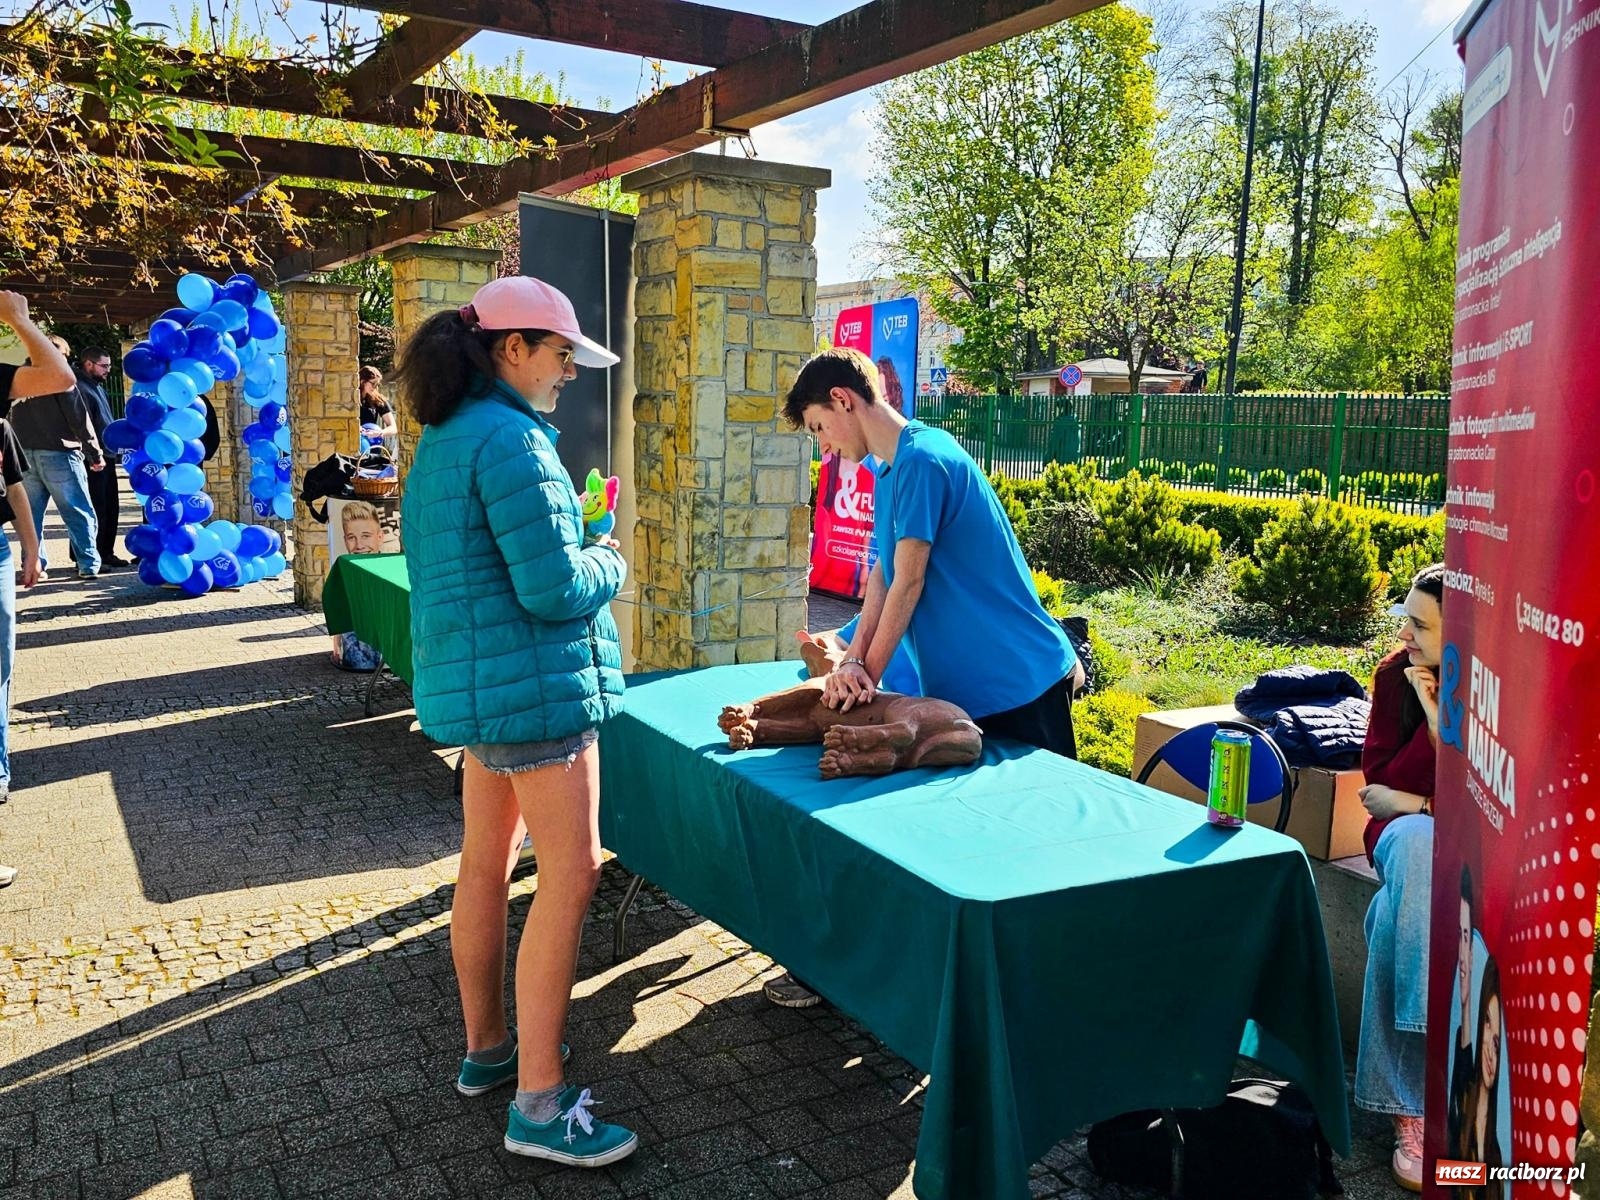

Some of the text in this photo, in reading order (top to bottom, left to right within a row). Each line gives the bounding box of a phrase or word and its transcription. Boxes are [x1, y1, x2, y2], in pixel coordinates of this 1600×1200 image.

[849, 321, 863, 334] TEB
[894, 314, 908, 328] TEB
[860, 492, 875, 511] FU
[1544, 613, 1560, 641] 42
[1561, 618, 1585, 647] 80
[1470, 654, 1501, 737] FUN
[1467, 712, 1516, 819] NAUKA
